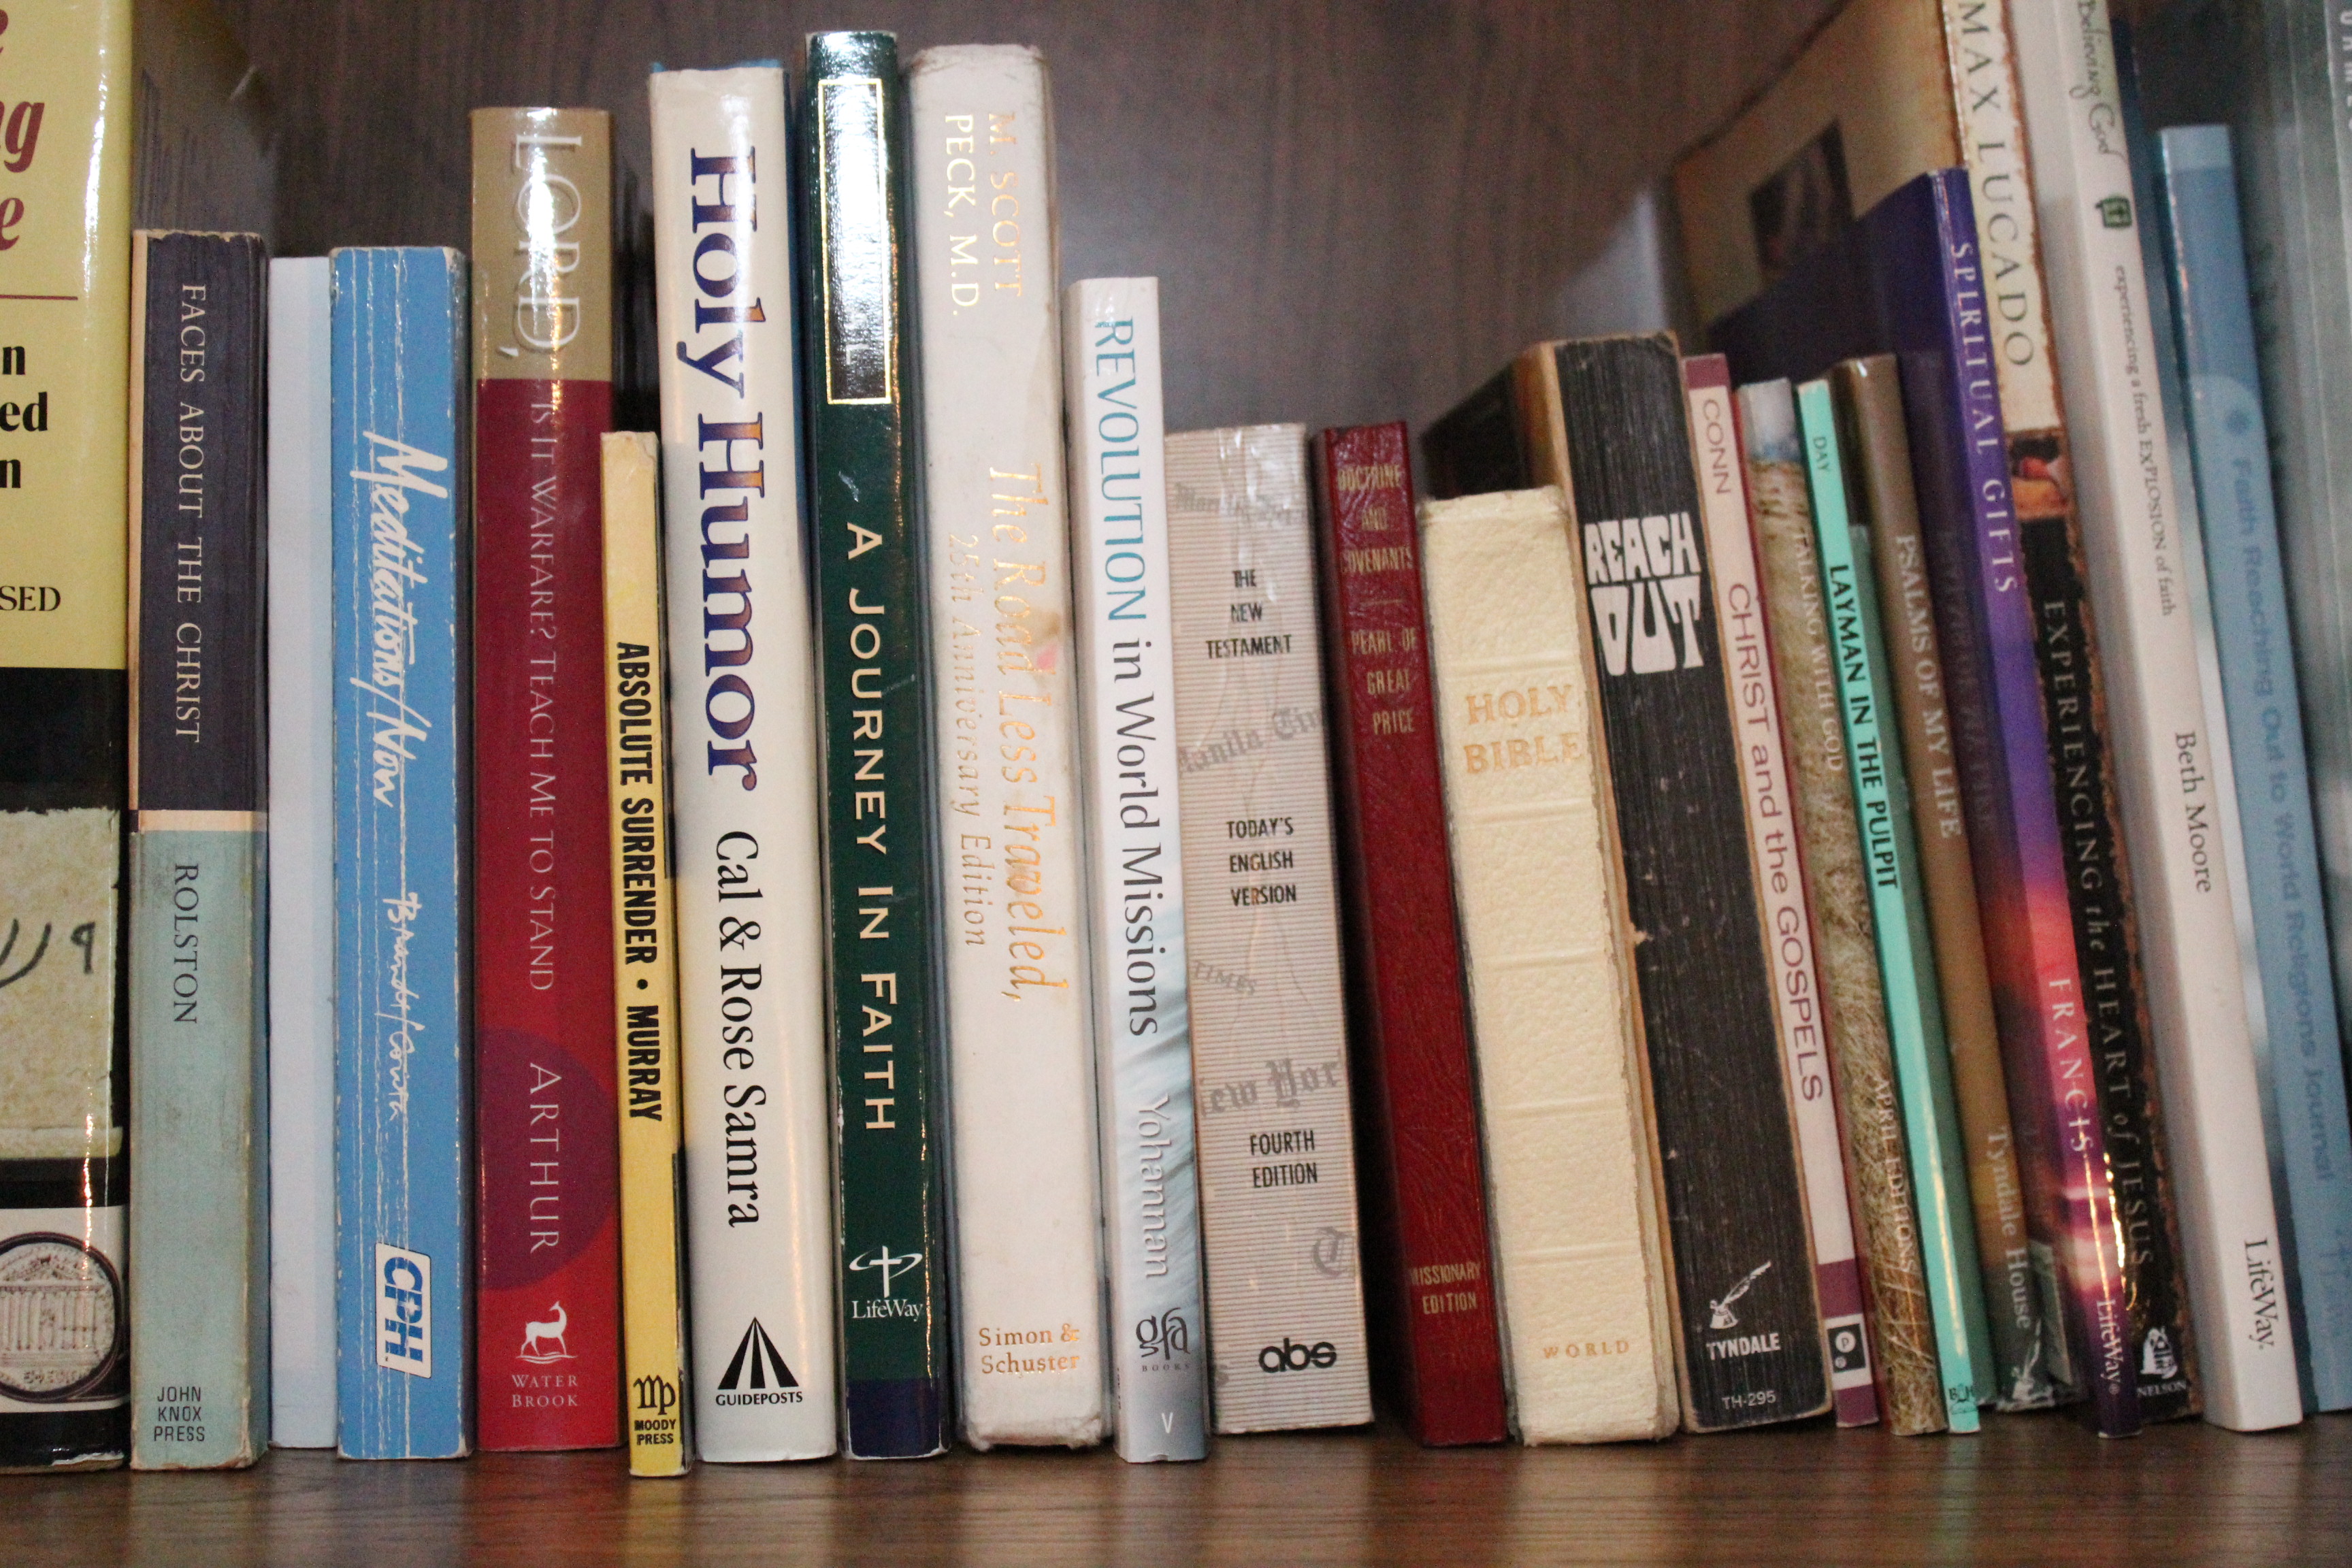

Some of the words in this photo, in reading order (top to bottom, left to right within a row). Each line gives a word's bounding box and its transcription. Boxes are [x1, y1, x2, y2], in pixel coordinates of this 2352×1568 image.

[1958, 3, 2001, 113] MAX
[944, 114, 976, 218] PECK,
[988, 112, 1017, 155] M.
[990, 171, 1023, 297] SCOTT
[1977, 141, 2034, 367] LUCADO
[675, 146, 767, 399] Holy
[949, 234, 980, 316] M.D.
[179, 283, 207, 383] FACES
[1702, 399, 1731, 495] CONN
[1813, 436, 1830, 473] DAY
[1949, 240, 1999, 454] SPIRITUAL
[1980, 478, 2019, 593] GIFTS
[178, 401, 205, 519] ABOUT
[1094, 317, 1147, 621] REVOLUTION
[2139, 438, 2168, 550] EXPLOSION
[846, 521, 883, 560] A
[989, 463, 1049, 543] The
[176, 536, 203, 604] THE
[948, 534, 984, 603] 25th
[1232, 569, 1257, 588] THE
[1584, 511, 1702, 585] REACH
[697, 411, 767, 791] Humor
[993, 559, 1056, 676] Road
[1230, 603, 1263, 623] NEW
[1590, 576, 1703, 676] OUT
[1830, 564, 1866, 682] LAYMAN
[1895, 536, 1930, 653] PSALMS
[175, 622, 201, 744] CHRIST
[1112, 637, 1152, 684] in
[1205, 634, 1292, 659] TESTAMENT
[1729, 582, 1770, 732] CHRIST
[1914, 658, 1939, 697] OF
[617, 642, 653, 785] ABSOLUTE
[849, 587, 887, 855] JOURNEY
[949, 617, 984, 817] Anniversary
[998, 690, 1053, 784] Less
[1372, 708, 1415, 736] PRICE
[1465, 684, 1572, 725] HOLY
[1850, 696, 1873, 725] IN
[1923, 709, 1948, 753] MY
[1115, 691, 1160, 830] World
[1463, 732, 1582, 774] BIBLE
[1750, 743, 1782, 819] and
[1857, 737, 1883, 789] THE
[2174, 731, 2204, 794] Beth
[1226, 817, 1294, 839] TODAY'S
[1931, 767, 1961, 838] LIFE
[621, 798, 657, 965] SURRENDER
[716, 830, 764, 902] Cal
[1229, 851, 1294, 873] ENGLISH
[1764, 828, 1788, 894] the
[1865, 800, 1898, 889] PULPIT
[2185, 803, 2215, 894] Moore
[961, 833, 996, 947] Edition
[1000, 796, 1069, 1002] Traveled,
[1230, 885, 1296, 906] VERSION
[172, 863, 200, 1024] ROLSTON
[718, 916, 762, 951] &
[1122, 843, 1166, 1036] Missions
[2043, 600, 2102, 889] EXPERIENCING
[2093, 966, 2132, 1096] HEART
[2115, 1159, 2154, 1262] JESUS
[720, 963, 764, 1071] Rose
[1777, 906, 1823, 1102] GOSPELS
[626, 1004, 663, 1123] MURRAY
[2048, 977, 2094, 1154] FRANCIS
[529, 1062, 562, 1254] ARTHUR
[723, 1083, 768, 1228] Samra
[1249, 1128, 1316, 1156] FOURTH
[1252, 1162, 1318, 1188] EDITION
[1137, 1092, 1173, 1280] Yohannan
[383, 1256, 424, 1362] CPH
[851, 1298, 924, 1322] LifeWay
[1409, 1261, 1482, 1286] MISSIONARY
[1422, 1292, 1477, 1315] EDITION
[2005, 1248, 2033, 1329] House
[979, 1328, 1054, 1347] Simon
[1060, 1323, 1080, 1342] &
[981, 1352, 1080, 1375] Schuster
[1258, 1337, 1338, 1373] abs
[1542, 1339, 1631, 1359] WORLD
[1705, 1333, 1781, 1361] TYNDALE
[157, 1386, 202, 1403] JOHN
[157, 1405, 202, 1422] KNOX
[634, 1418, 676, 1432] MOODY
[715, 1390, 804, 1407] GUIDEPOSTS
[1721, 1390, 1776, 1410] TH-295
[154, 1425, 205, 1443] PRESS
[636, 1433, 674, 1446] PRESS
